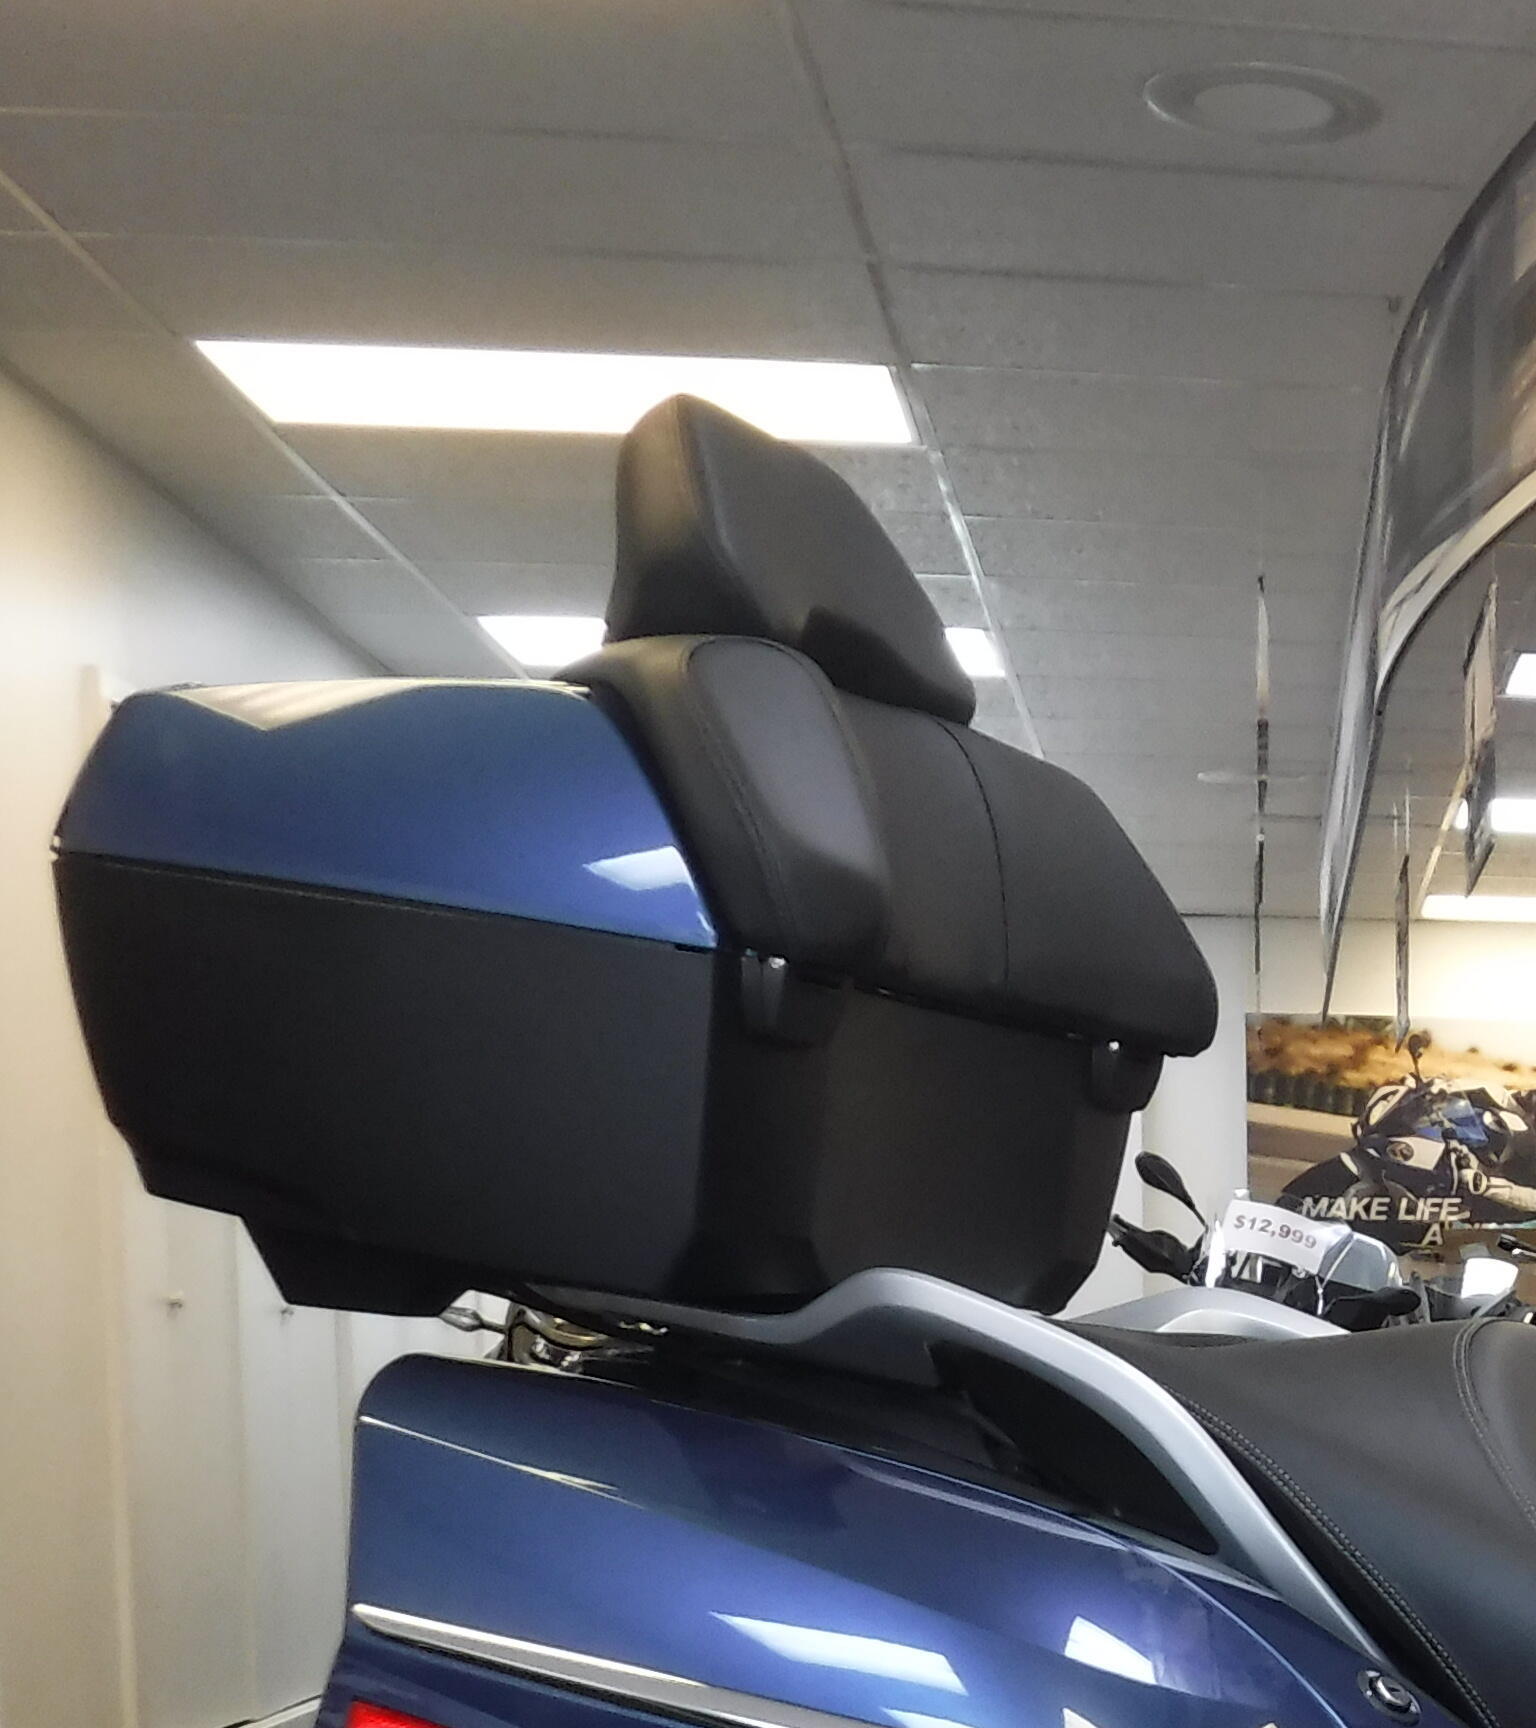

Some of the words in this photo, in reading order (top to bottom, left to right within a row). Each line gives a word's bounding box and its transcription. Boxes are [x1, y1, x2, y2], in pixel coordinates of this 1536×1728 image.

[1302, 1196, 1390, 1221] MAKE
[1399, 1196, 1464, 1222] LIFE
[1233, 1214, 1318, 1250] $12,999
